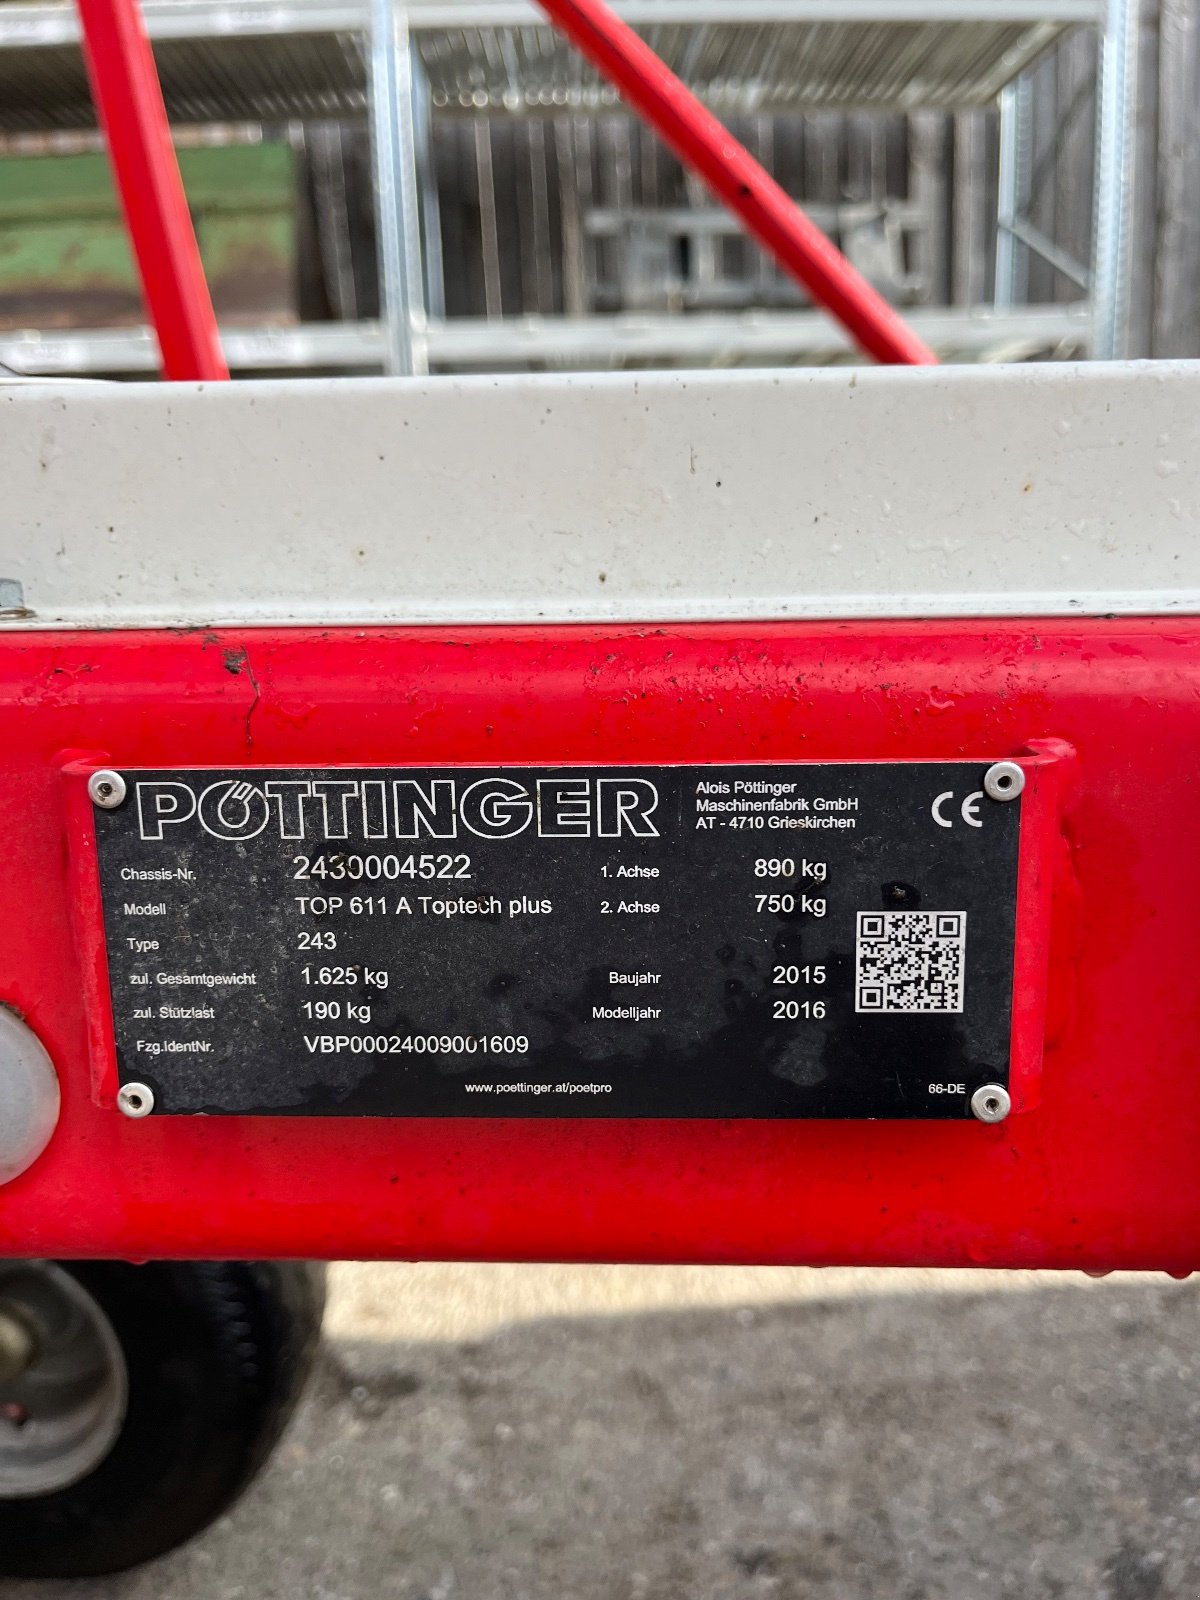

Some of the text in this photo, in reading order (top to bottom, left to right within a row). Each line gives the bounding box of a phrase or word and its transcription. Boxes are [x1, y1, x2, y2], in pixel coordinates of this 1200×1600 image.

[696, 780, 798, 797] Alois Pöttinger
[136, 777, 661, 841] PÖTTINGER
[696, 798, 859, 812] Maschinenfabrik GmbH
[931, 791, 984, 827] CE
[695, 817, 717, 829] AT
[729, 816, 764, 829] 4710
[767, 815, 856, 829] Grieskirchen
[120, 867, 198, 881] Chassis-Nr.
[293, 854, 472, 880] 2430004522
[600, 864, 660, 878] 1. Achse
[754, 858, 828, 880] 890 kg
[124, 903, 167, 915] Modell
[295, 896, 553, 918] TOP 611 A Toptech plus
[600, 899, 661, 913] 2. Achse
[755, 893, 827, 917] 750 kg
[127, 937, 160, 952] Type
[297, 931, 337, 950] 243
[130, 972, 257, 987] zul. Gesamtgewicht
[301, 967, 389, 989] 1.625 kg
[609, 971, 661, 987] Baujahr
[773, 965, 827, 985] 2015
[133, 1005, 215, 1019] zul. Stützlast
[303, 1001, 371, 1023] 190 kg
[592, 1006, 661, 1020] Modelljahr
[773, 1000, 826, 1019] 2016
[136, 1039, 215, 1055] Fzg.IdentNr.
[304, 1035, 529, 1053] VBP00024009001609
[465, 1082, 612, 1095] www.poettinger.at/poetpro
[928, 1083, 966, 1094] 66-DE
